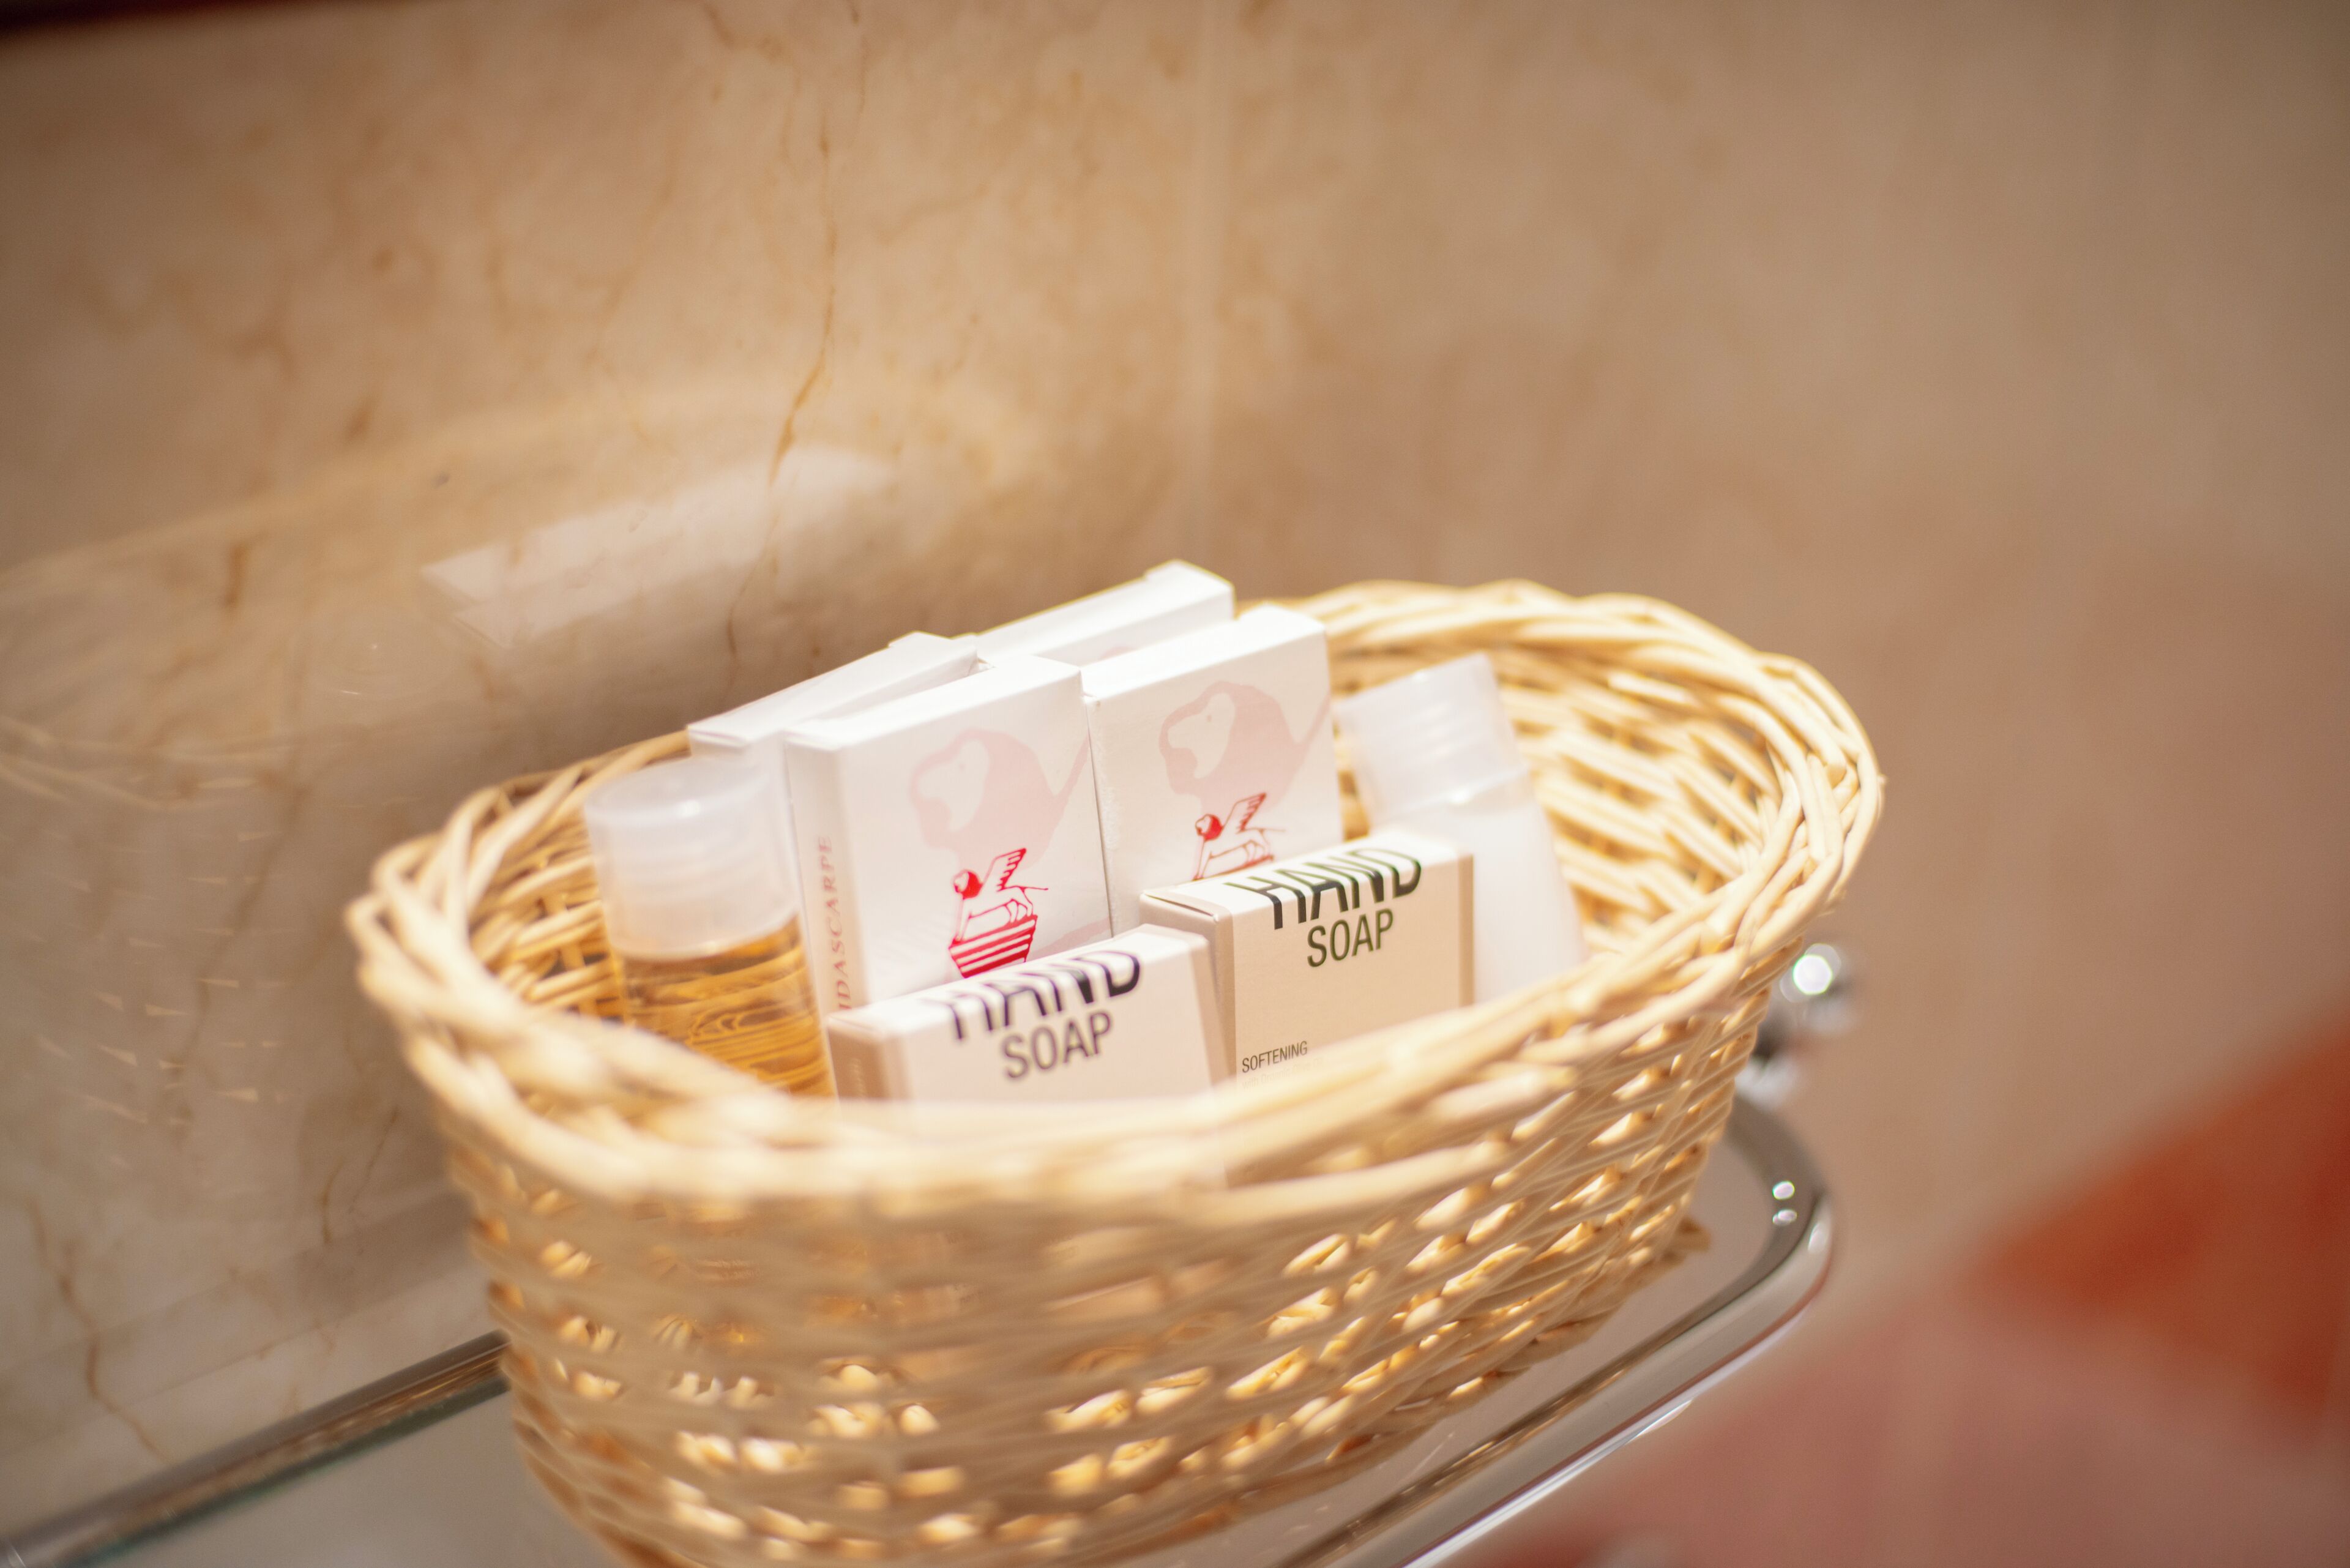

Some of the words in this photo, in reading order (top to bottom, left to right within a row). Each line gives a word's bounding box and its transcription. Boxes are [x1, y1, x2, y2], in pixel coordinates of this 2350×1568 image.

[1222, 848, 1421, 930] HAND
[1307, 908, 1393, 968] SOAP
[920, 951, 1141, 1040] HAND
[1002, 1012, 1112, 1079] SOAP
[1242, 1040, 1308, 1073] SOFTENING
